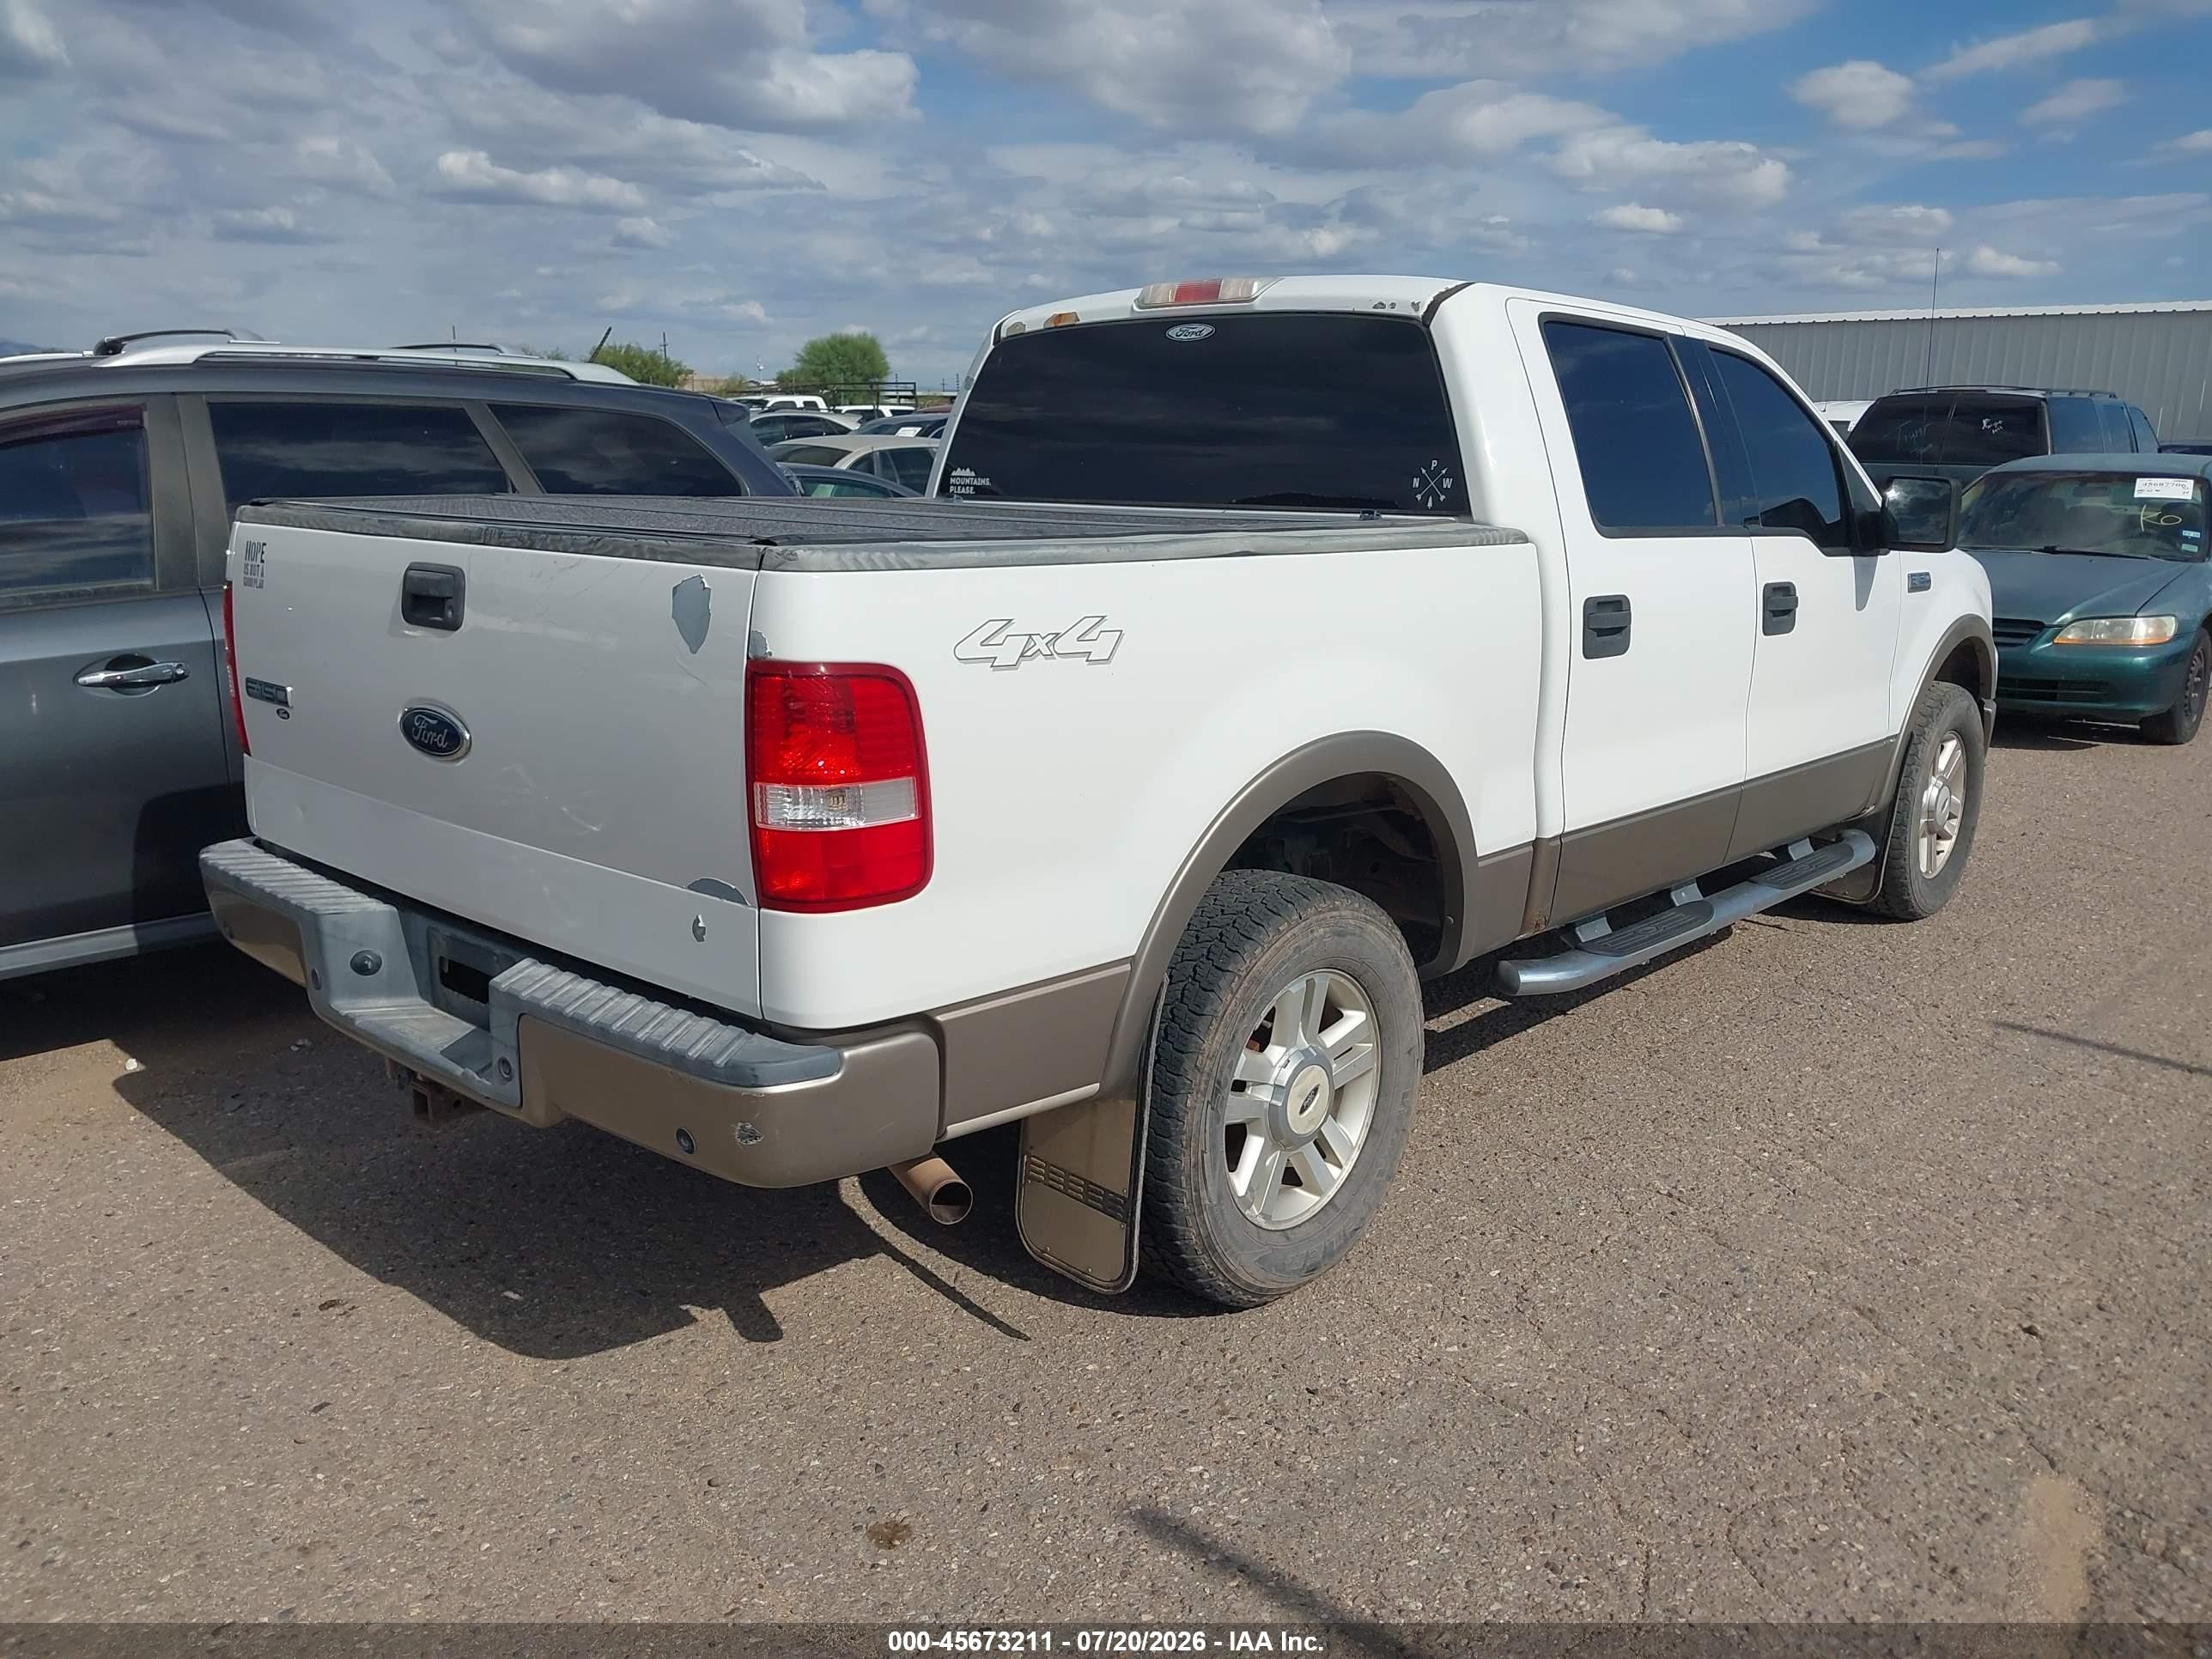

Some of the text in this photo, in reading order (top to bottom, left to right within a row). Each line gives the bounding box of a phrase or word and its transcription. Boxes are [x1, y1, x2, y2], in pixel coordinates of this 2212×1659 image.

[1430, 459, 1438, 471] P
[949, 477, 992, 487] MOUNTAINS,
[1412, 477, 1420, 489] N
[1443, 477, 1453, 489] W
[949, 485, 976, 495] PLEASE.
[244, 540, 267, 564] HOPE
[953, 615, 1125, 672] 4x4
[412, 714, 448, 749] Ford
